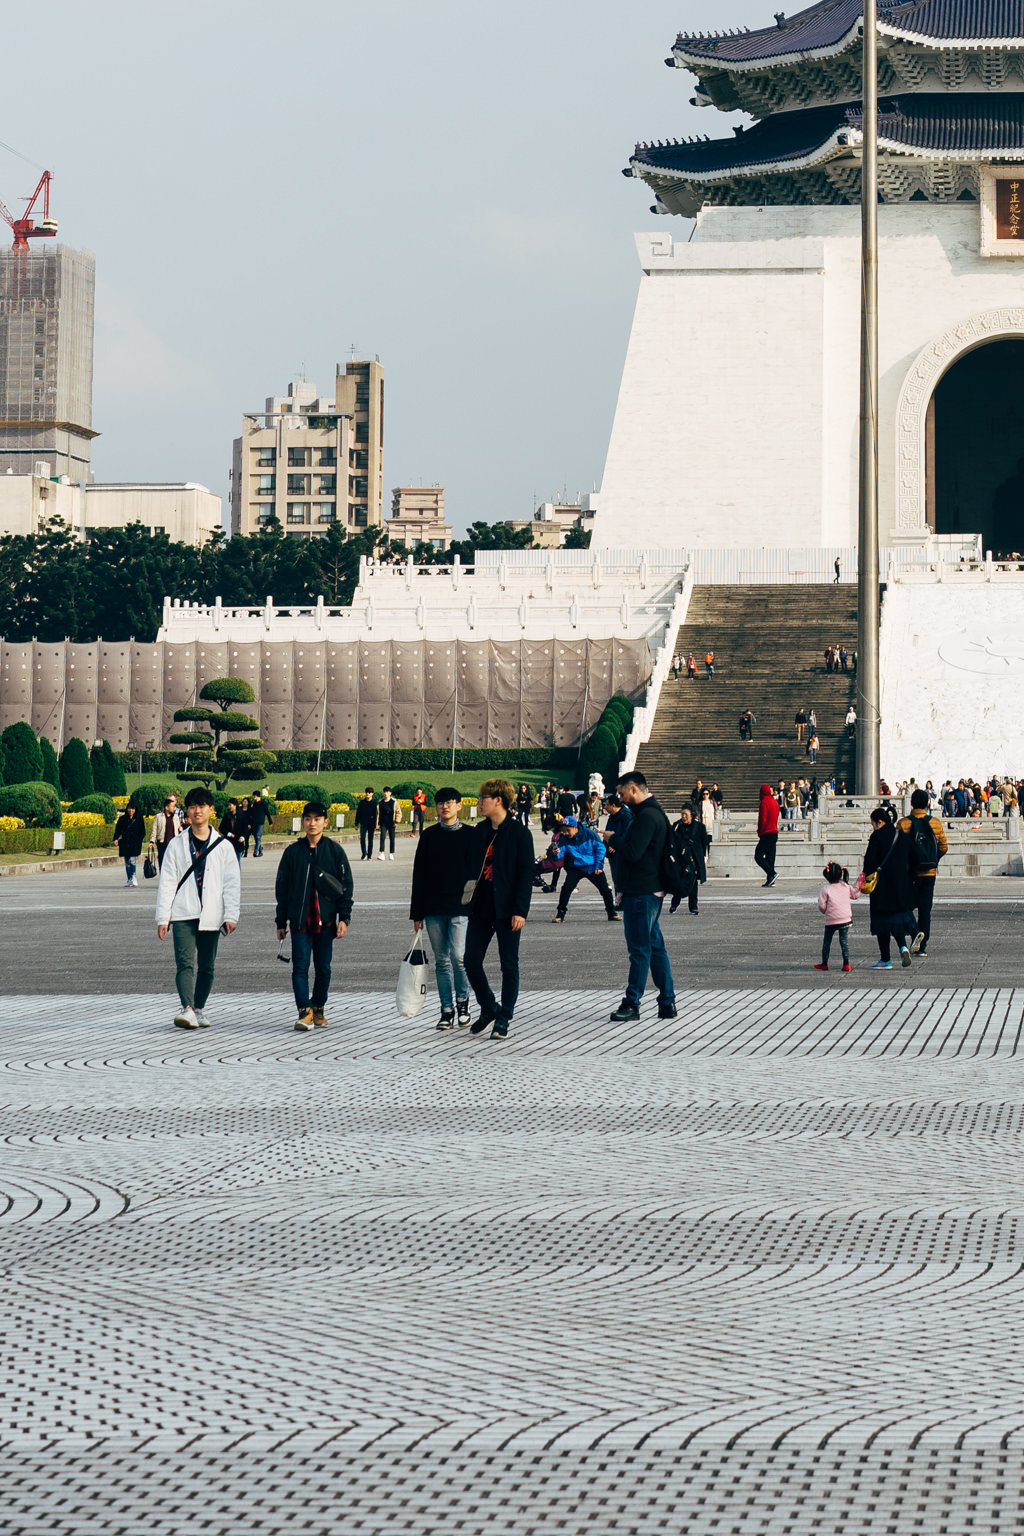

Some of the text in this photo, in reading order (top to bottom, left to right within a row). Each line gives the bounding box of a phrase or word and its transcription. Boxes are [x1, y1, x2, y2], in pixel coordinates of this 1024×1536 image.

[1009, 181, 1021, 236] 中正紀念堂
